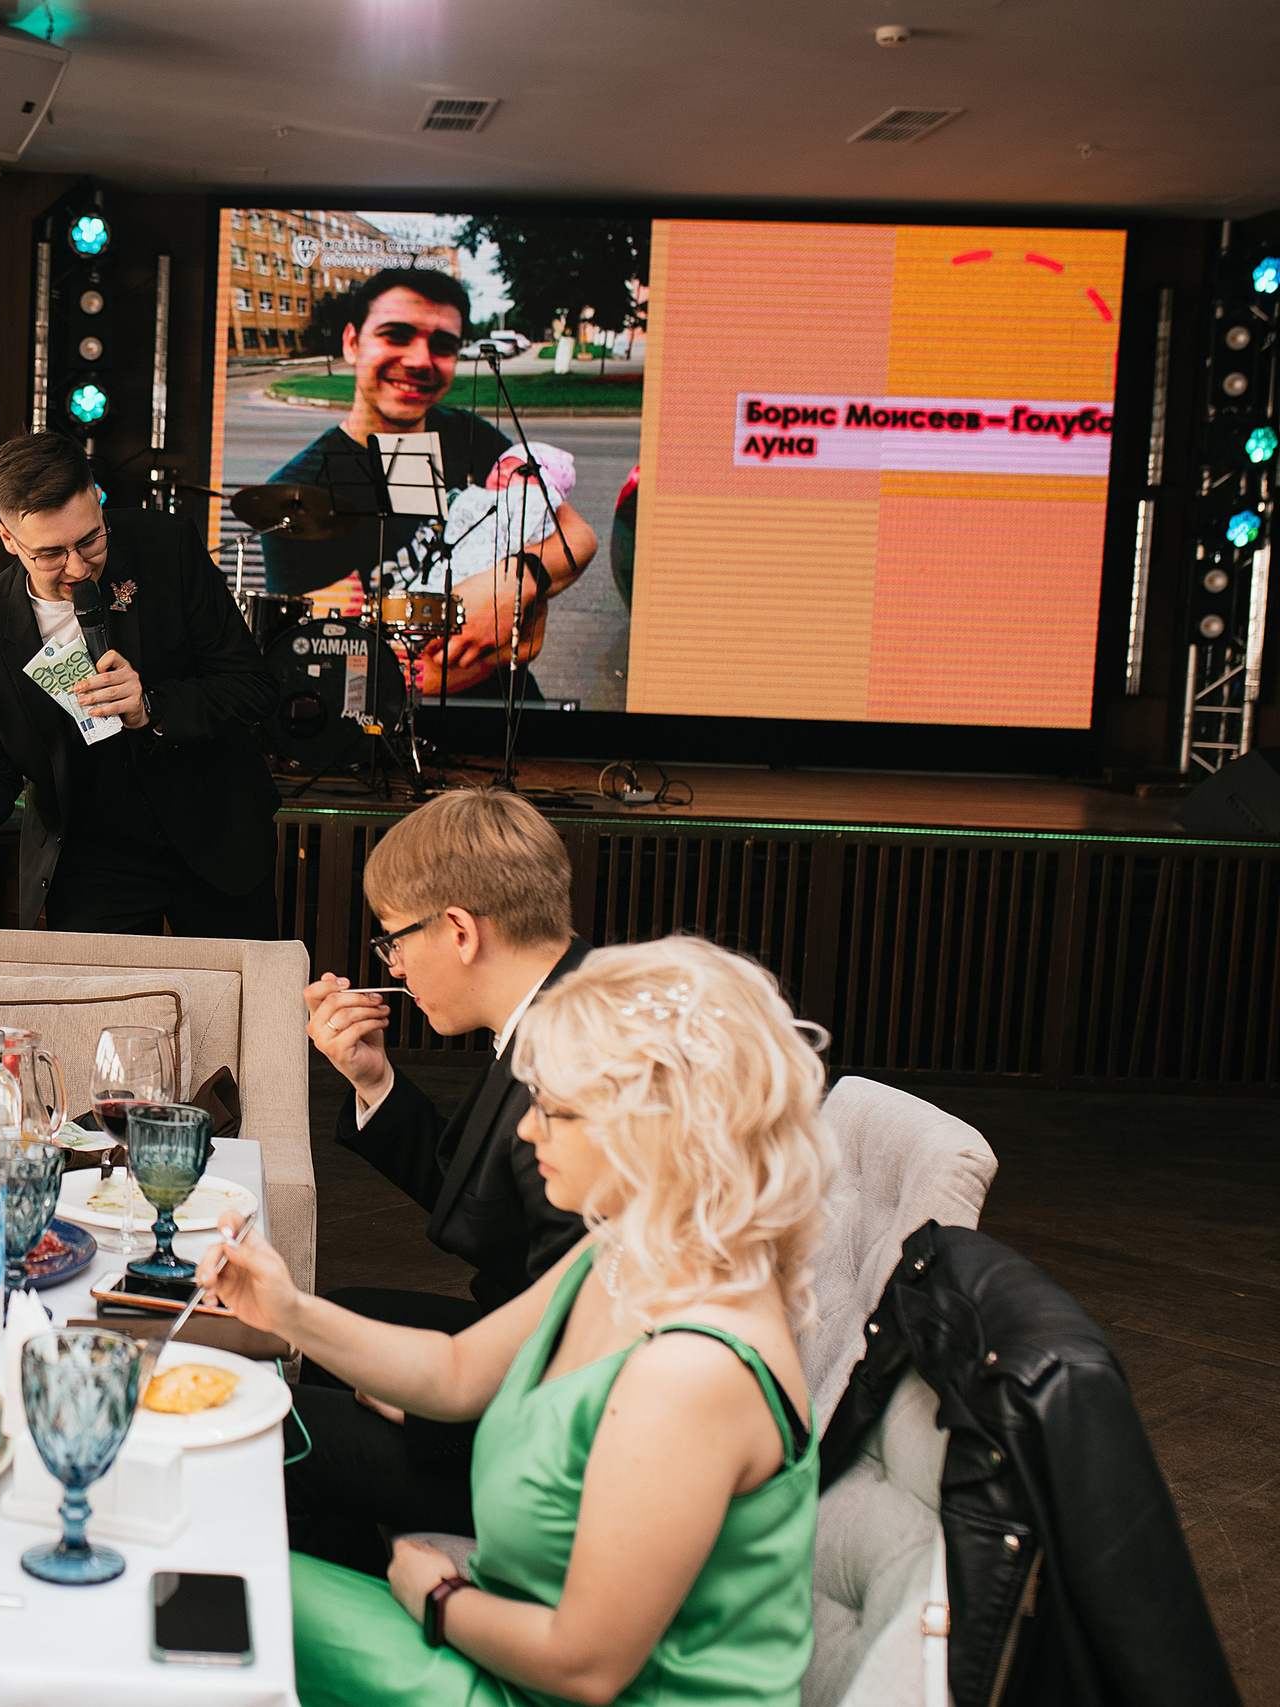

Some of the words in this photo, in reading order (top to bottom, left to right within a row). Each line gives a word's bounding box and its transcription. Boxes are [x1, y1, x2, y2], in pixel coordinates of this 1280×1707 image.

[745, 401, 837, 430] Борис
[846, 404, 981, 430] Моисеев
[743, 434, 815, 459] луна
[311, 638, 369, 656] YAMAHA
[32, 667, 58, 694] 100
